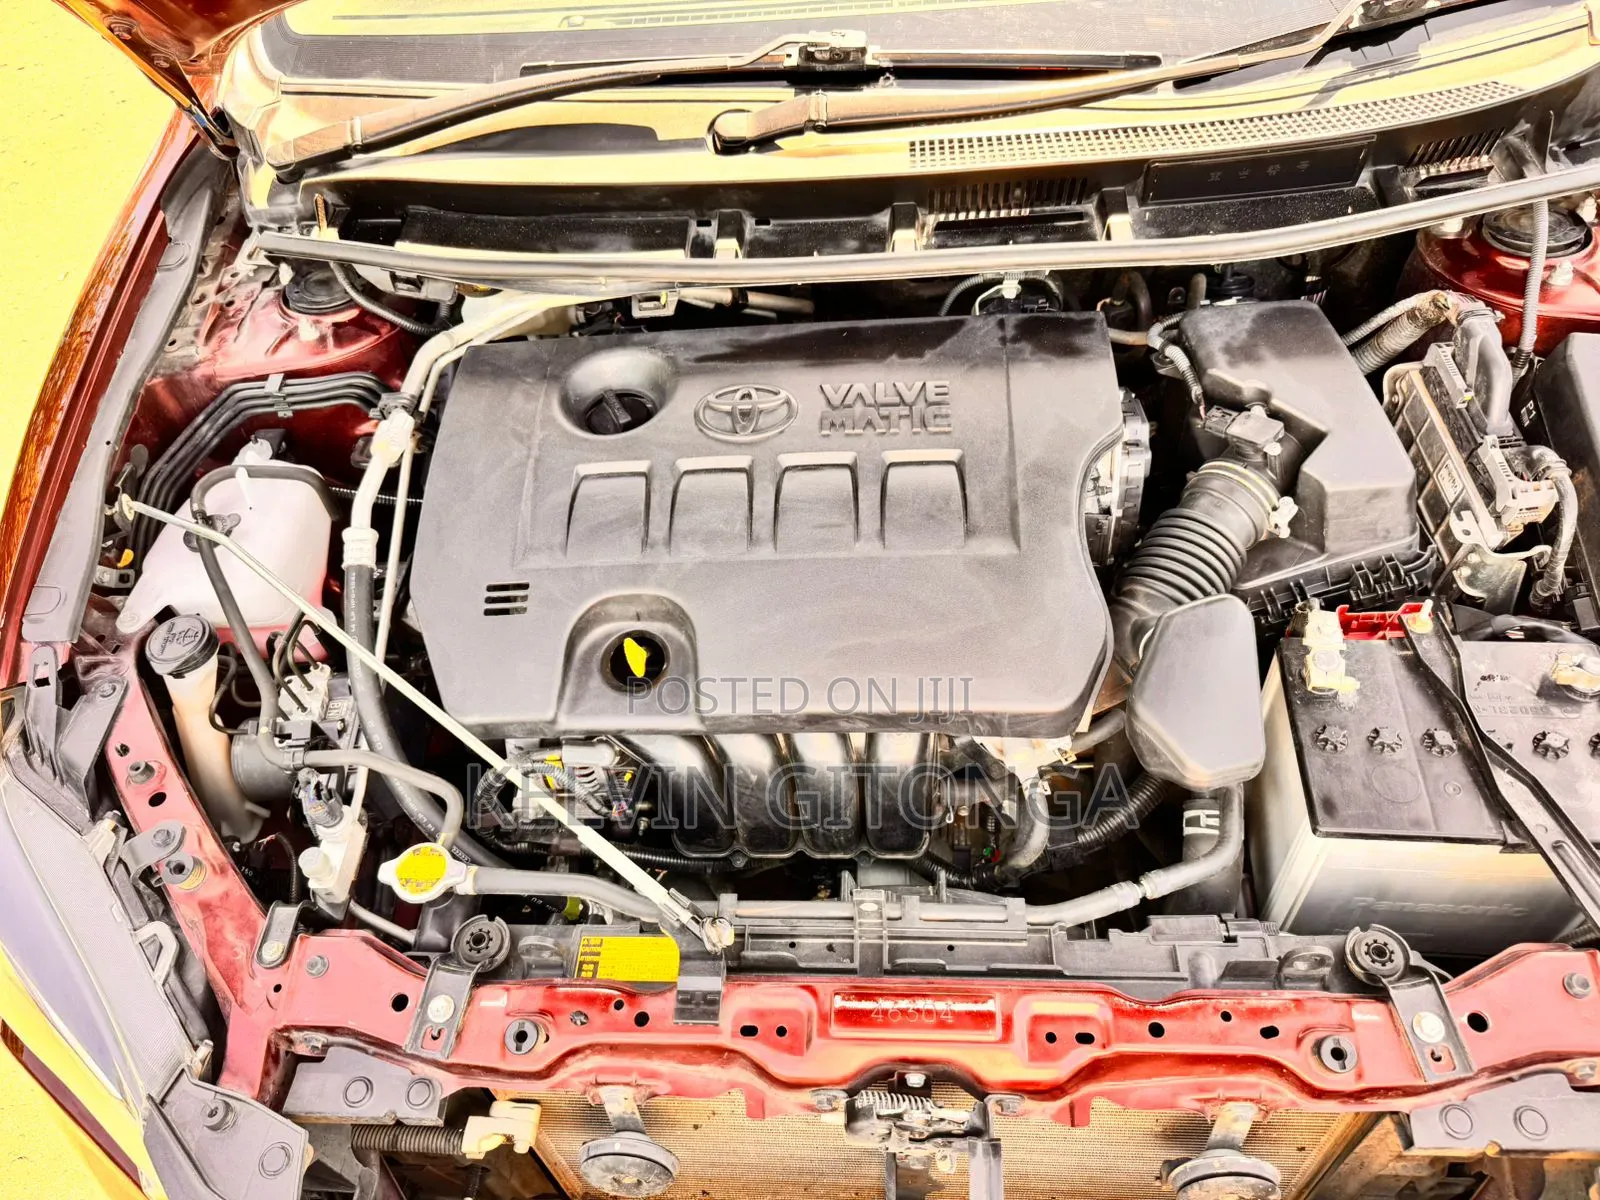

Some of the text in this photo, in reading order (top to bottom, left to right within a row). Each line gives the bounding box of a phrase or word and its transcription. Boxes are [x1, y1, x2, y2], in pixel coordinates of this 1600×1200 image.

[819, 380, 950, 409] VALVE
[819, 406, 953, 437] MATIC
[871, 997, 954, 1023] 46304
